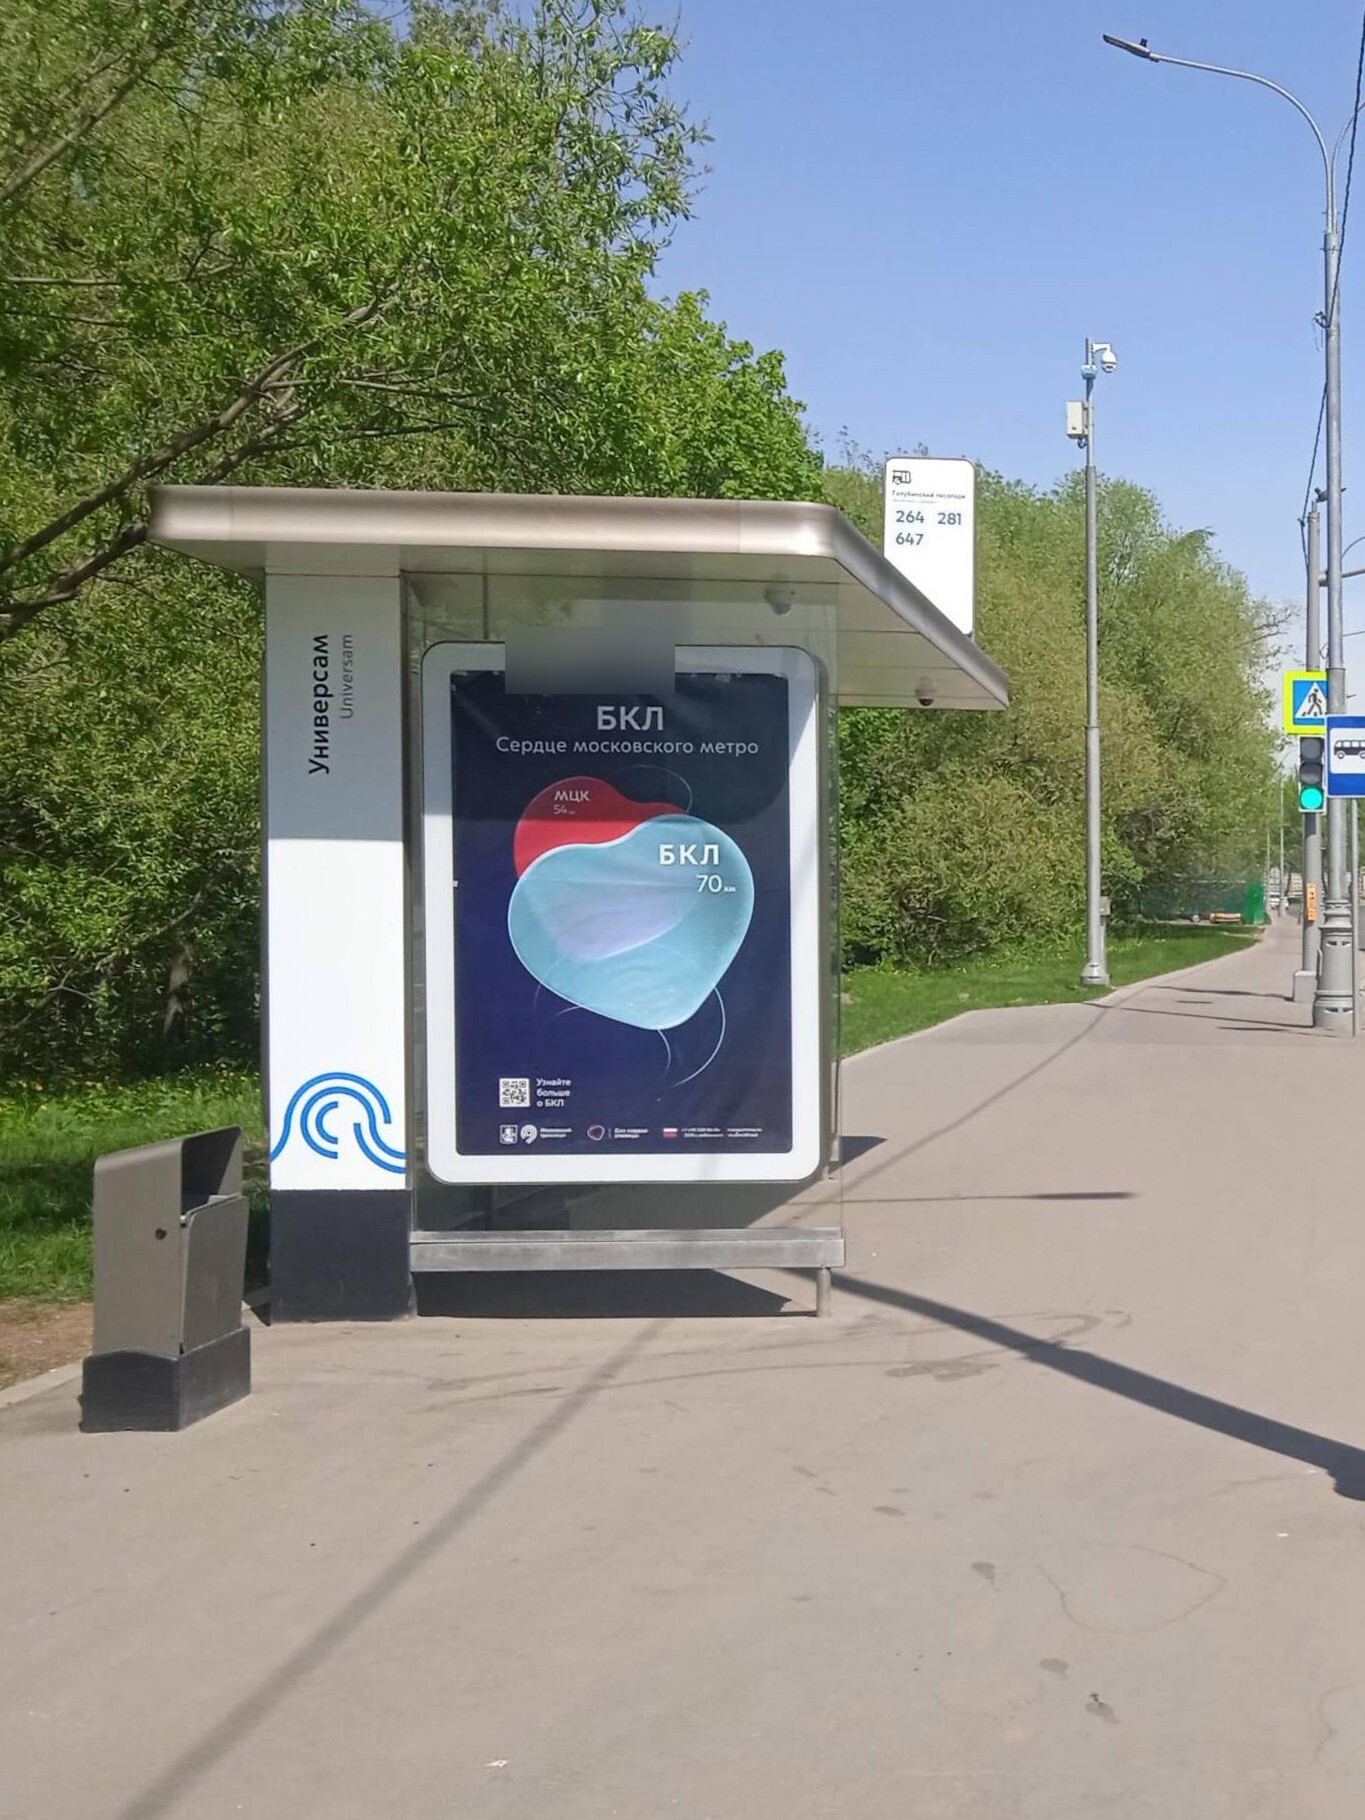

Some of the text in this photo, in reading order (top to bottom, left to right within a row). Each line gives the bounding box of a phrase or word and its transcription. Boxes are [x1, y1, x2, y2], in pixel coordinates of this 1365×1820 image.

[896, 510, 962, 525] 264 281
[896, 532, 924, 545] 647
[340, 634, 354, 719] Universam
[308, 634, 334, 775] Универсам
[597, 706, 664, 731] БКЛ
[496, 736, 759, 757] Сердце московского метро
[553, 804, 568, 815] 54
[659, 844, 719, 865] БКЛ
[697, 874, 722, 893] 70
[536, 1078, 571, 1086] Узнайте
[536, 1088, 571, 1097] больше
[545, 1099, 565, 1107] БКЛ
